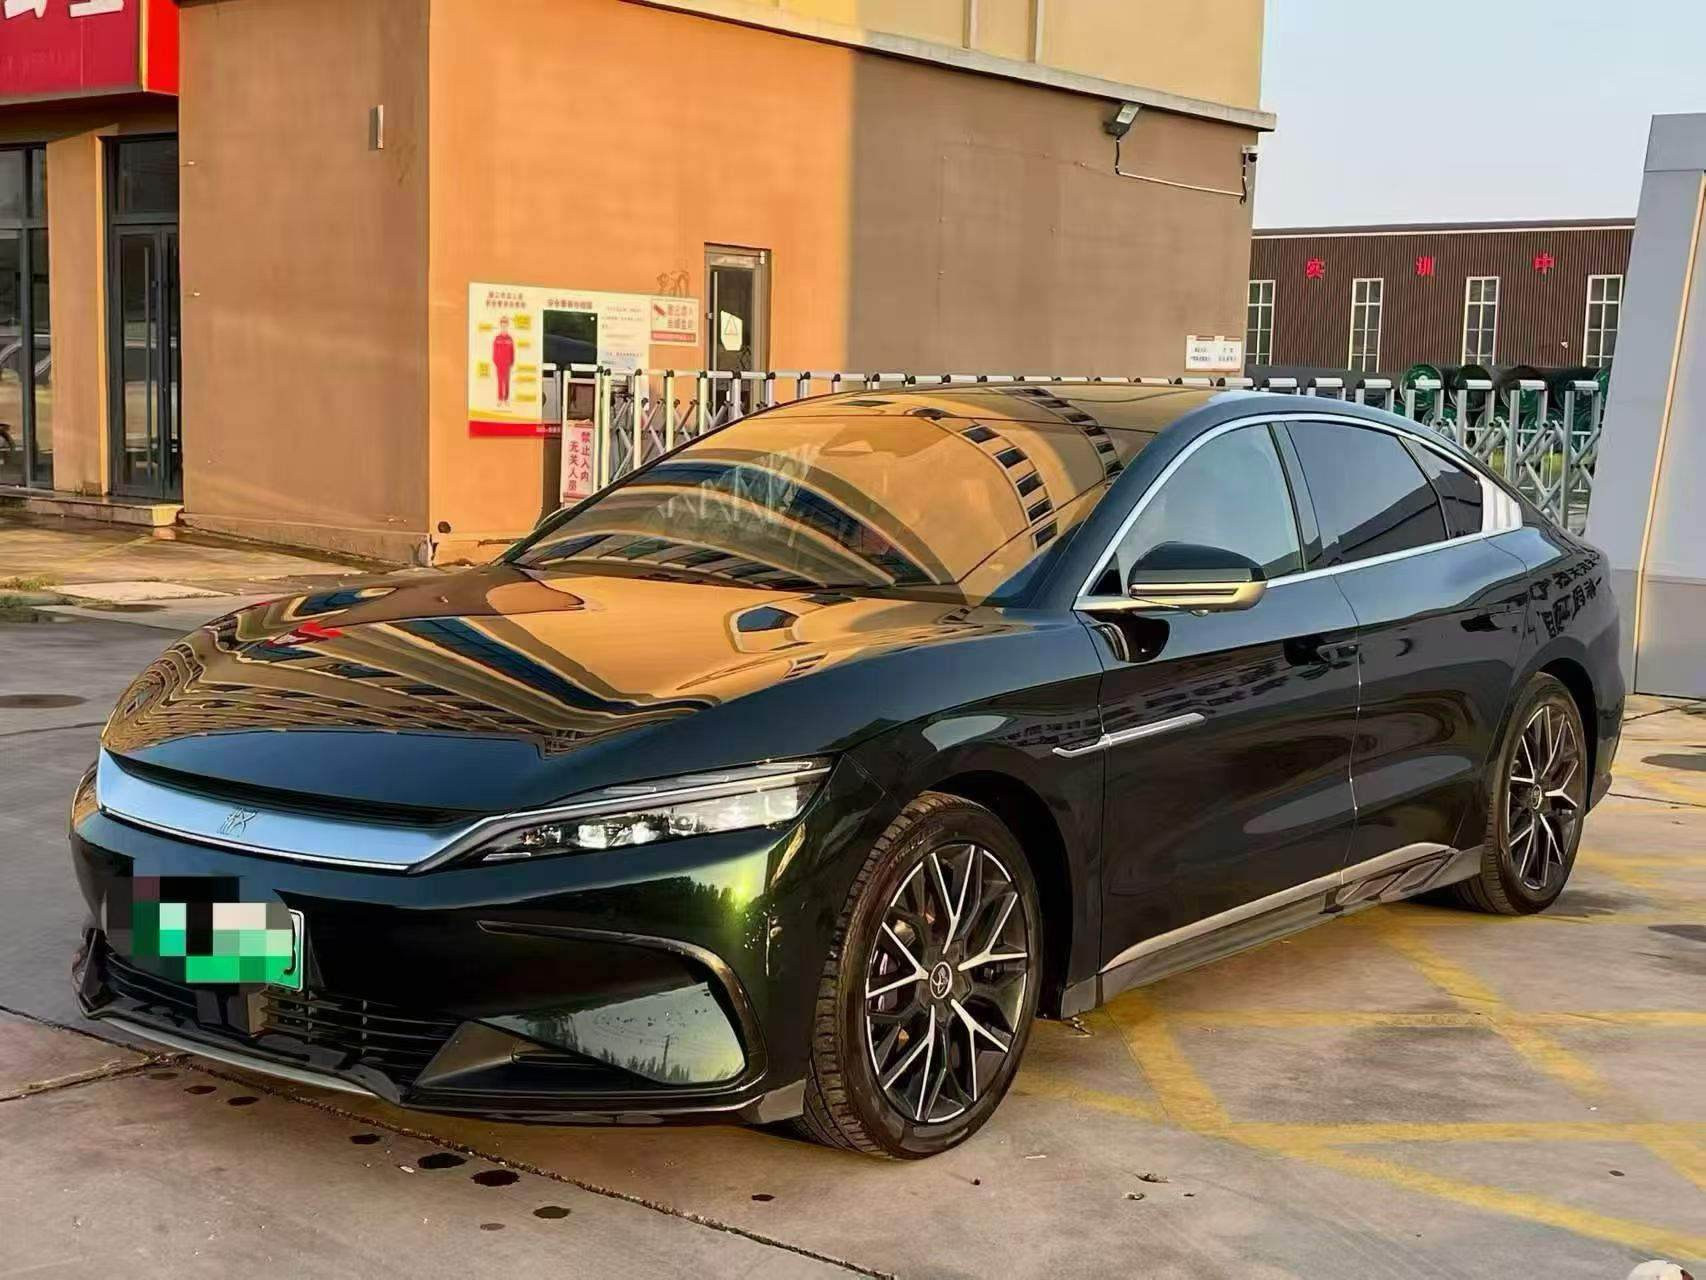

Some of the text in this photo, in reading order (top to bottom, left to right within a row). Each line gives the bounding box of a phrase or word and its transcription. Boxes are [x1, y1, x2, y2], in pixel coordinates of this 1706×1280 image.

[568, 440, 579, 491] 无关人员
[580, 431, 591, 482] 禁止入内
